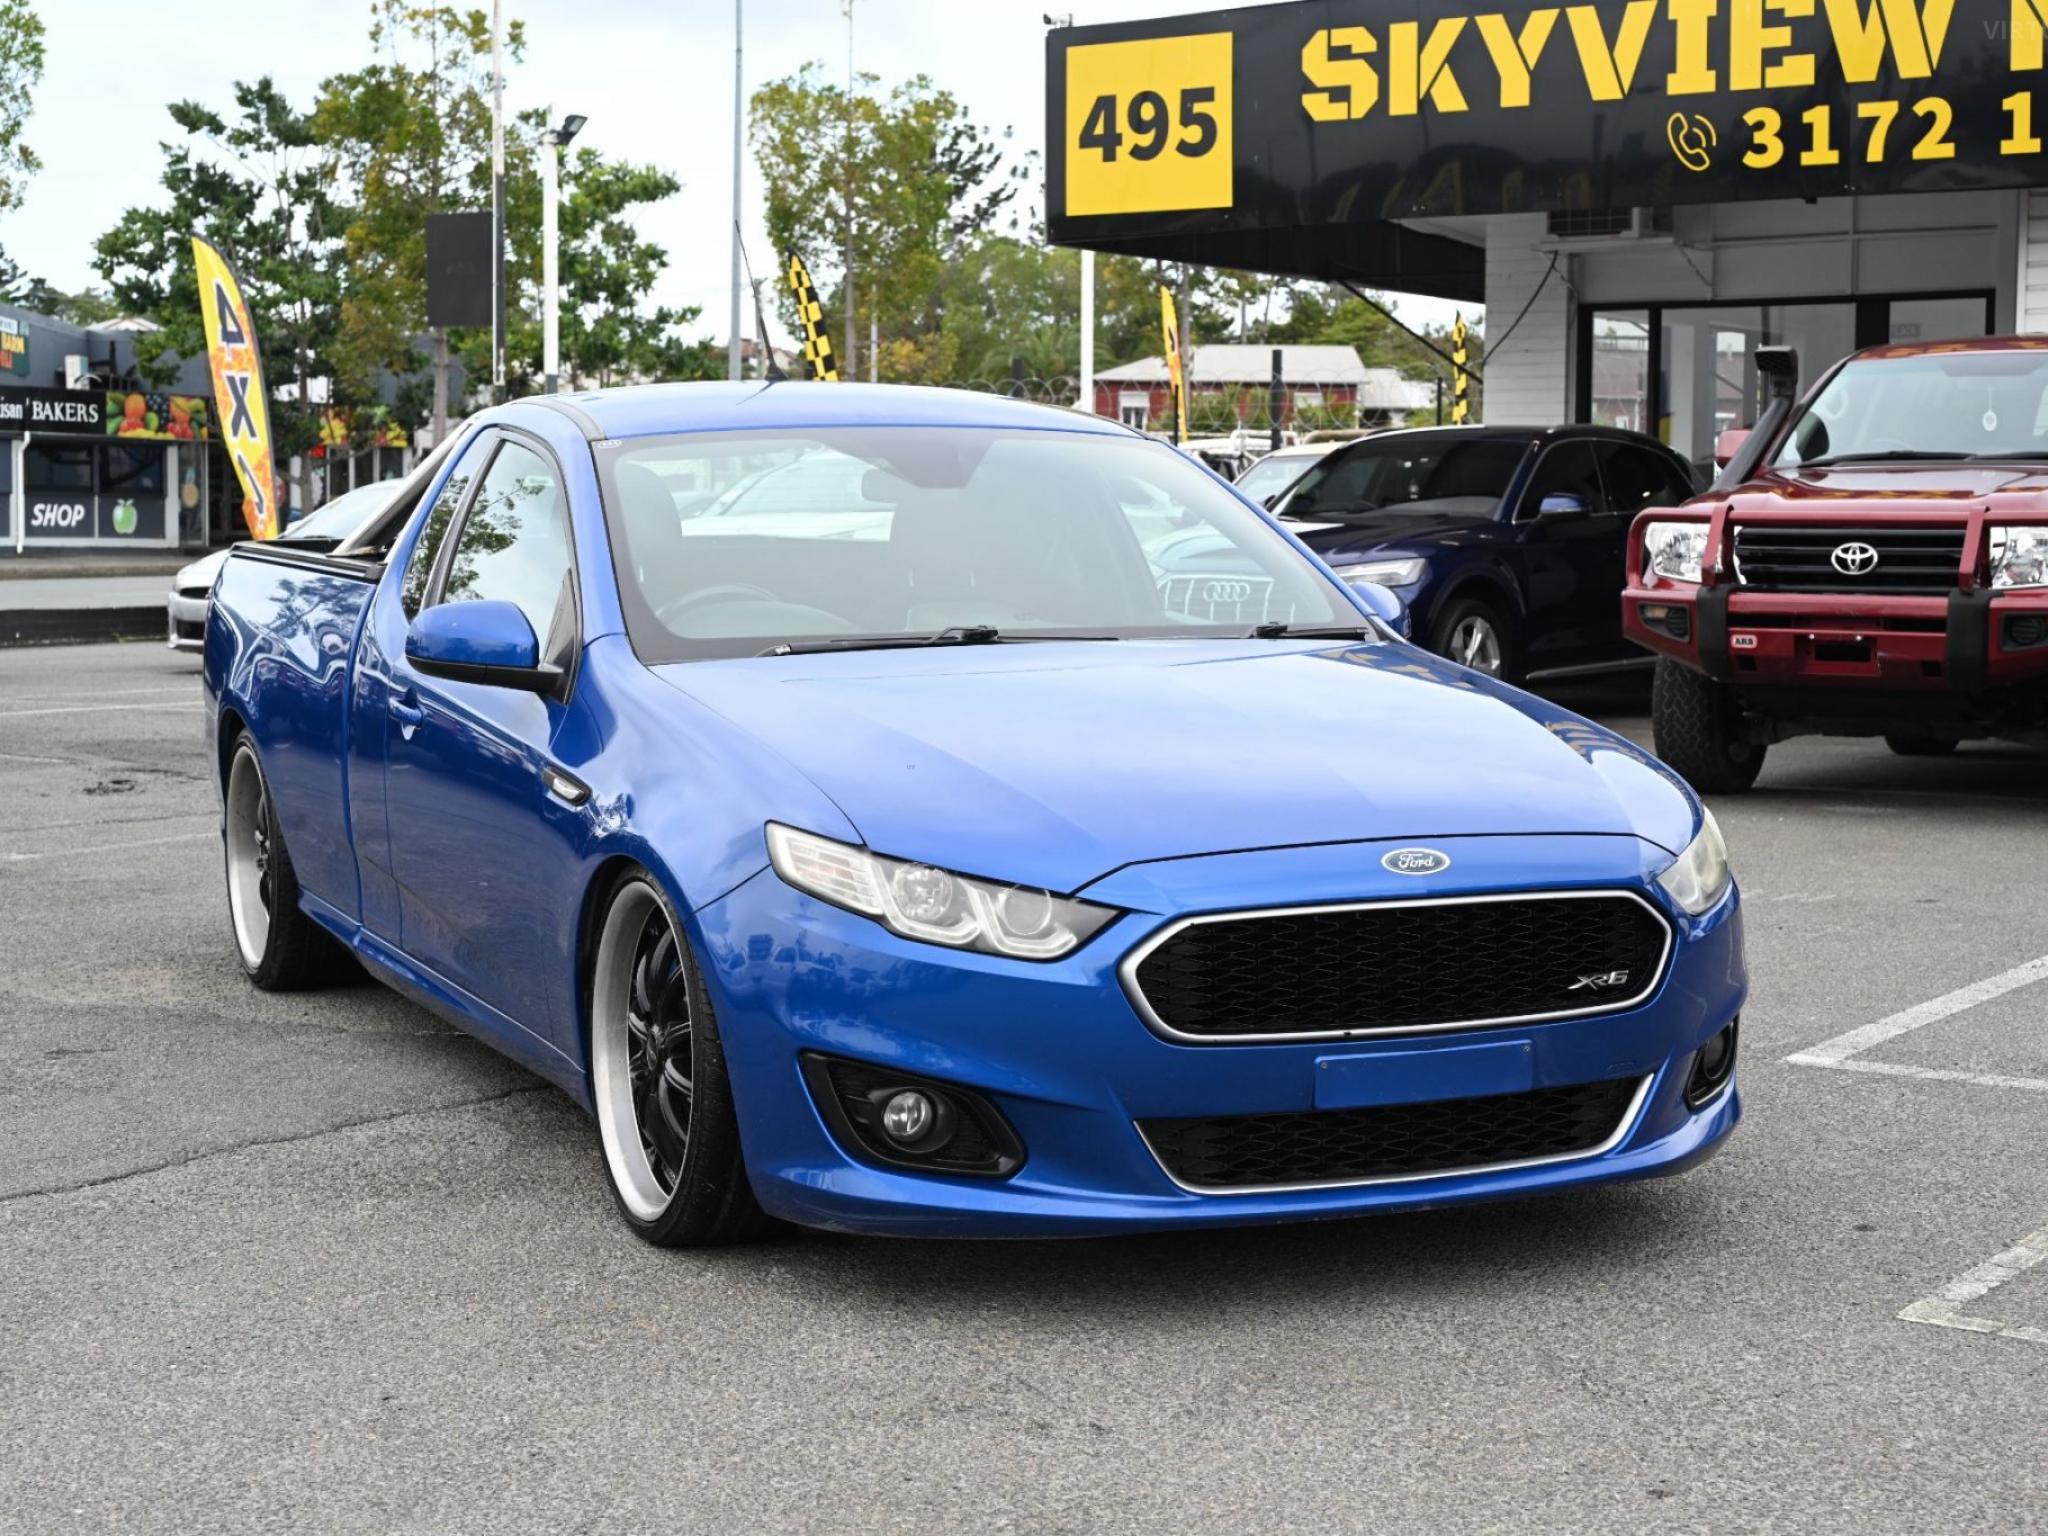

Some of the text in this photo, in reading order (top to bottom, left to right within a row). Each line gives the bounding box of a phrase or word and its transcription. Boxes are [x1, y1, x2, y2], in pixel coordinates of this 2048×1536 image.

[1303, 0, 1956, 121] SKYVIEW
[1079, 86, 1218, 163] 495
[1743, 91, 2041, 170] 3172 1
[0, 396, 99, 424] isan BAKERS
[31, 503, 85, 527] SHOP
[1397, 853, 1436, 869] Ford
[1567, 969, 1630, 991] XR6
